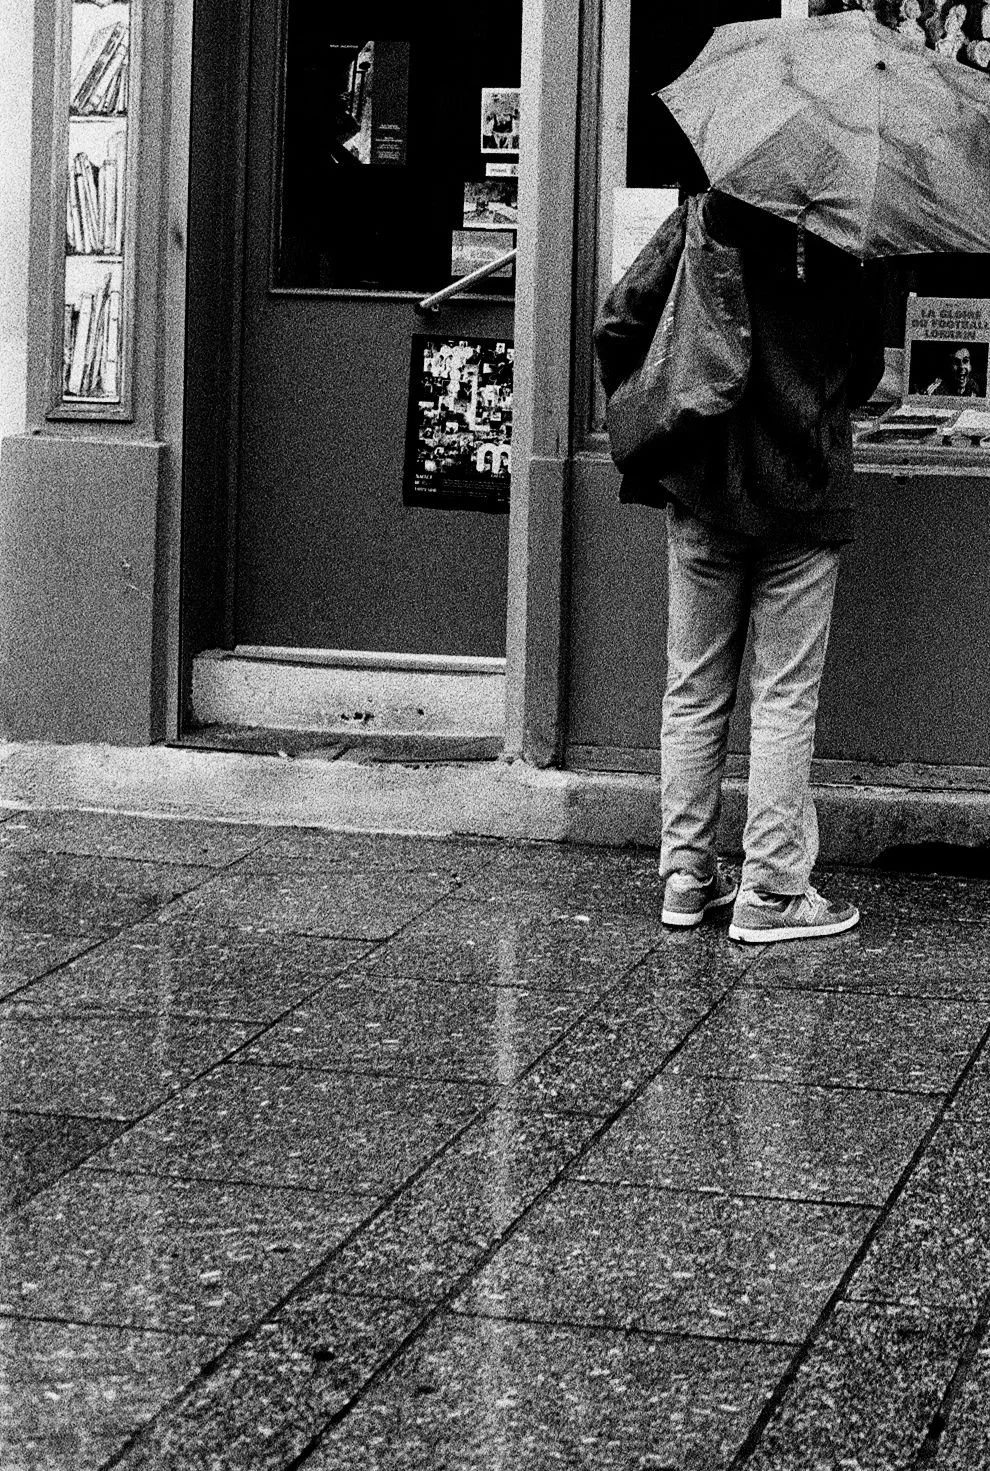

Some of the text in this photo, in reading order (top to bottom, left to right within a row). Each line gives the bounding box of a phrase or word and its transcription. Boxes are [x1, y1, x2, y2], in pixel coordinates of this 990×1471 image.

[921, 309, 936, 319] LA
[911, 319, 990, 330] DU FOOTBALL
